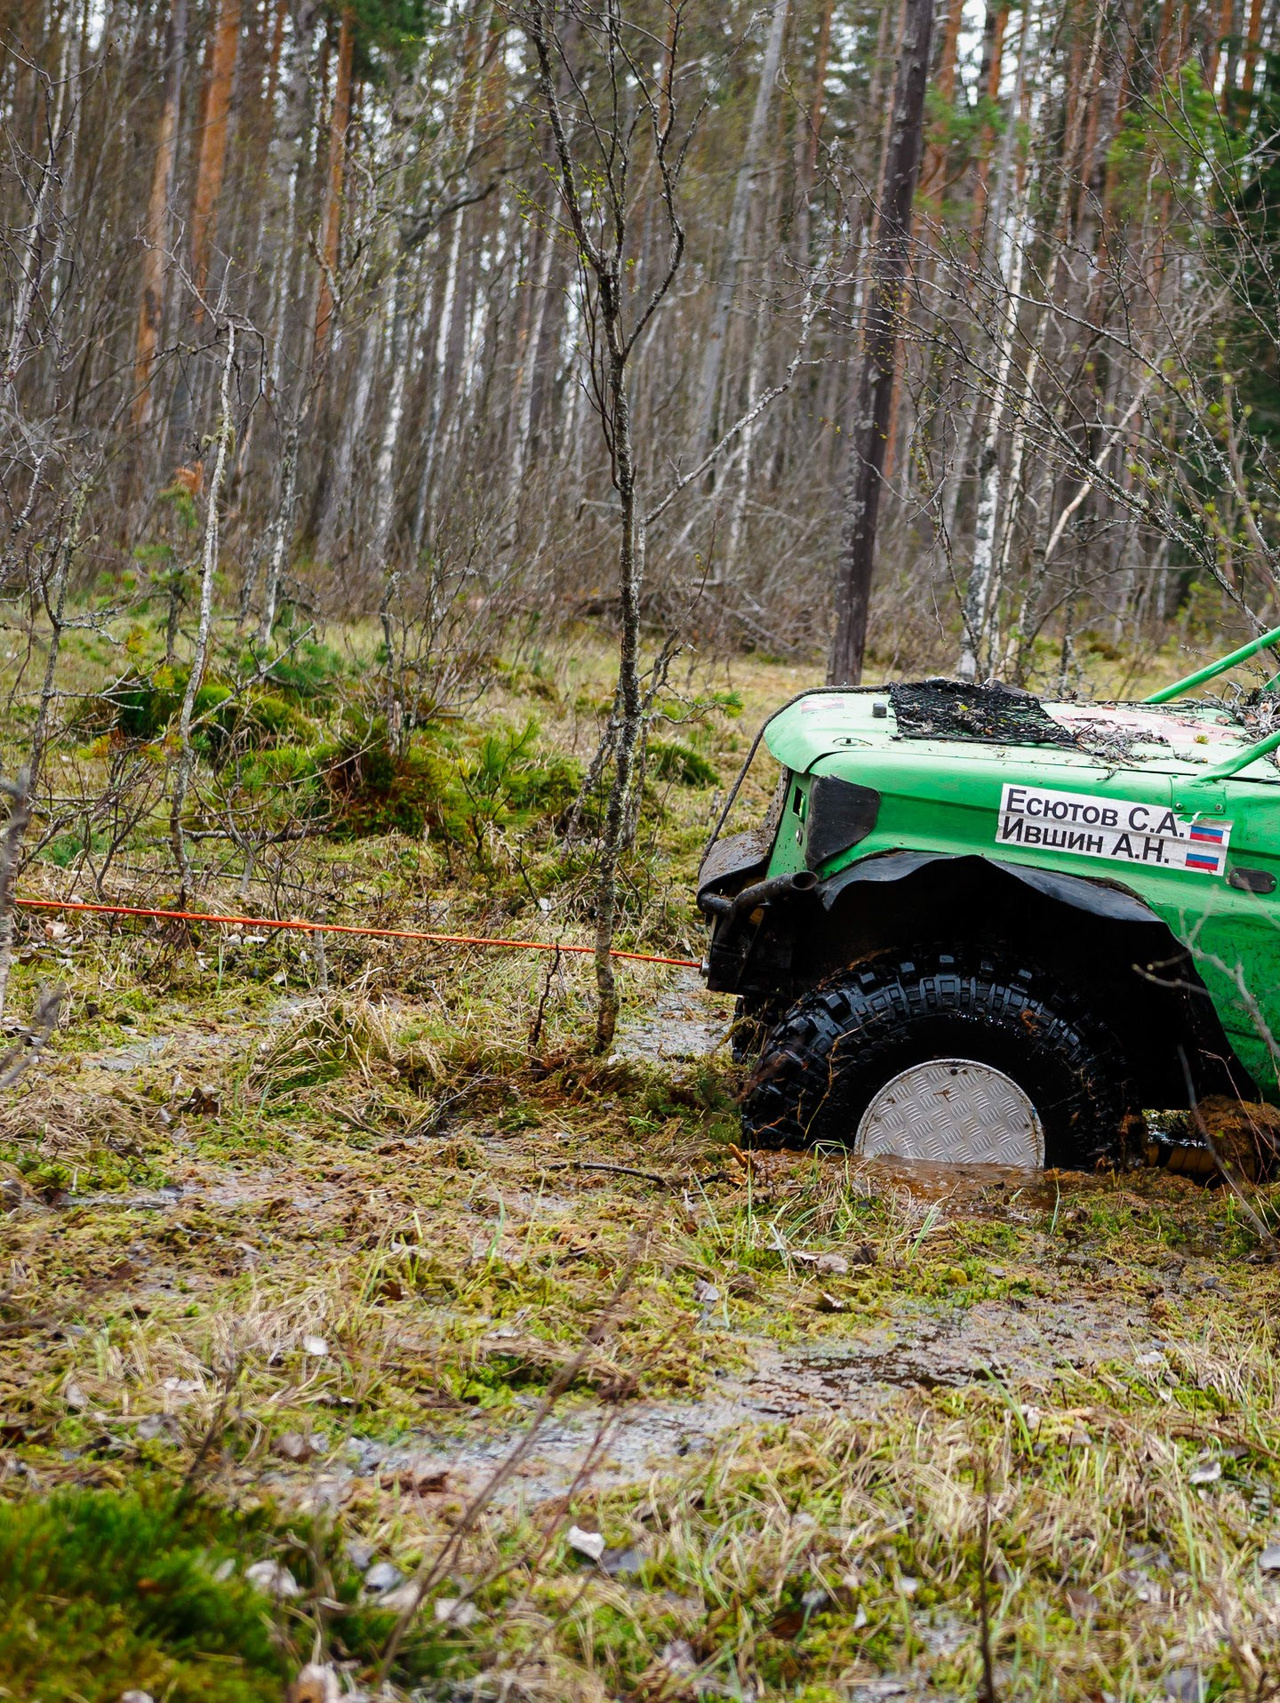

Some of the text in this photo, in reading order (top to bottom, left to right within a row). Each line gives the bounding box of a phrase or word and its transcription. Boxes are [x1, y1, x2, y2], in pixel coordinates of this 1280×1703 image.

[1006, 788, 1185, 838] Есютов С.А.
[1002, 816, 1169, 864] Ившин А.Н.
